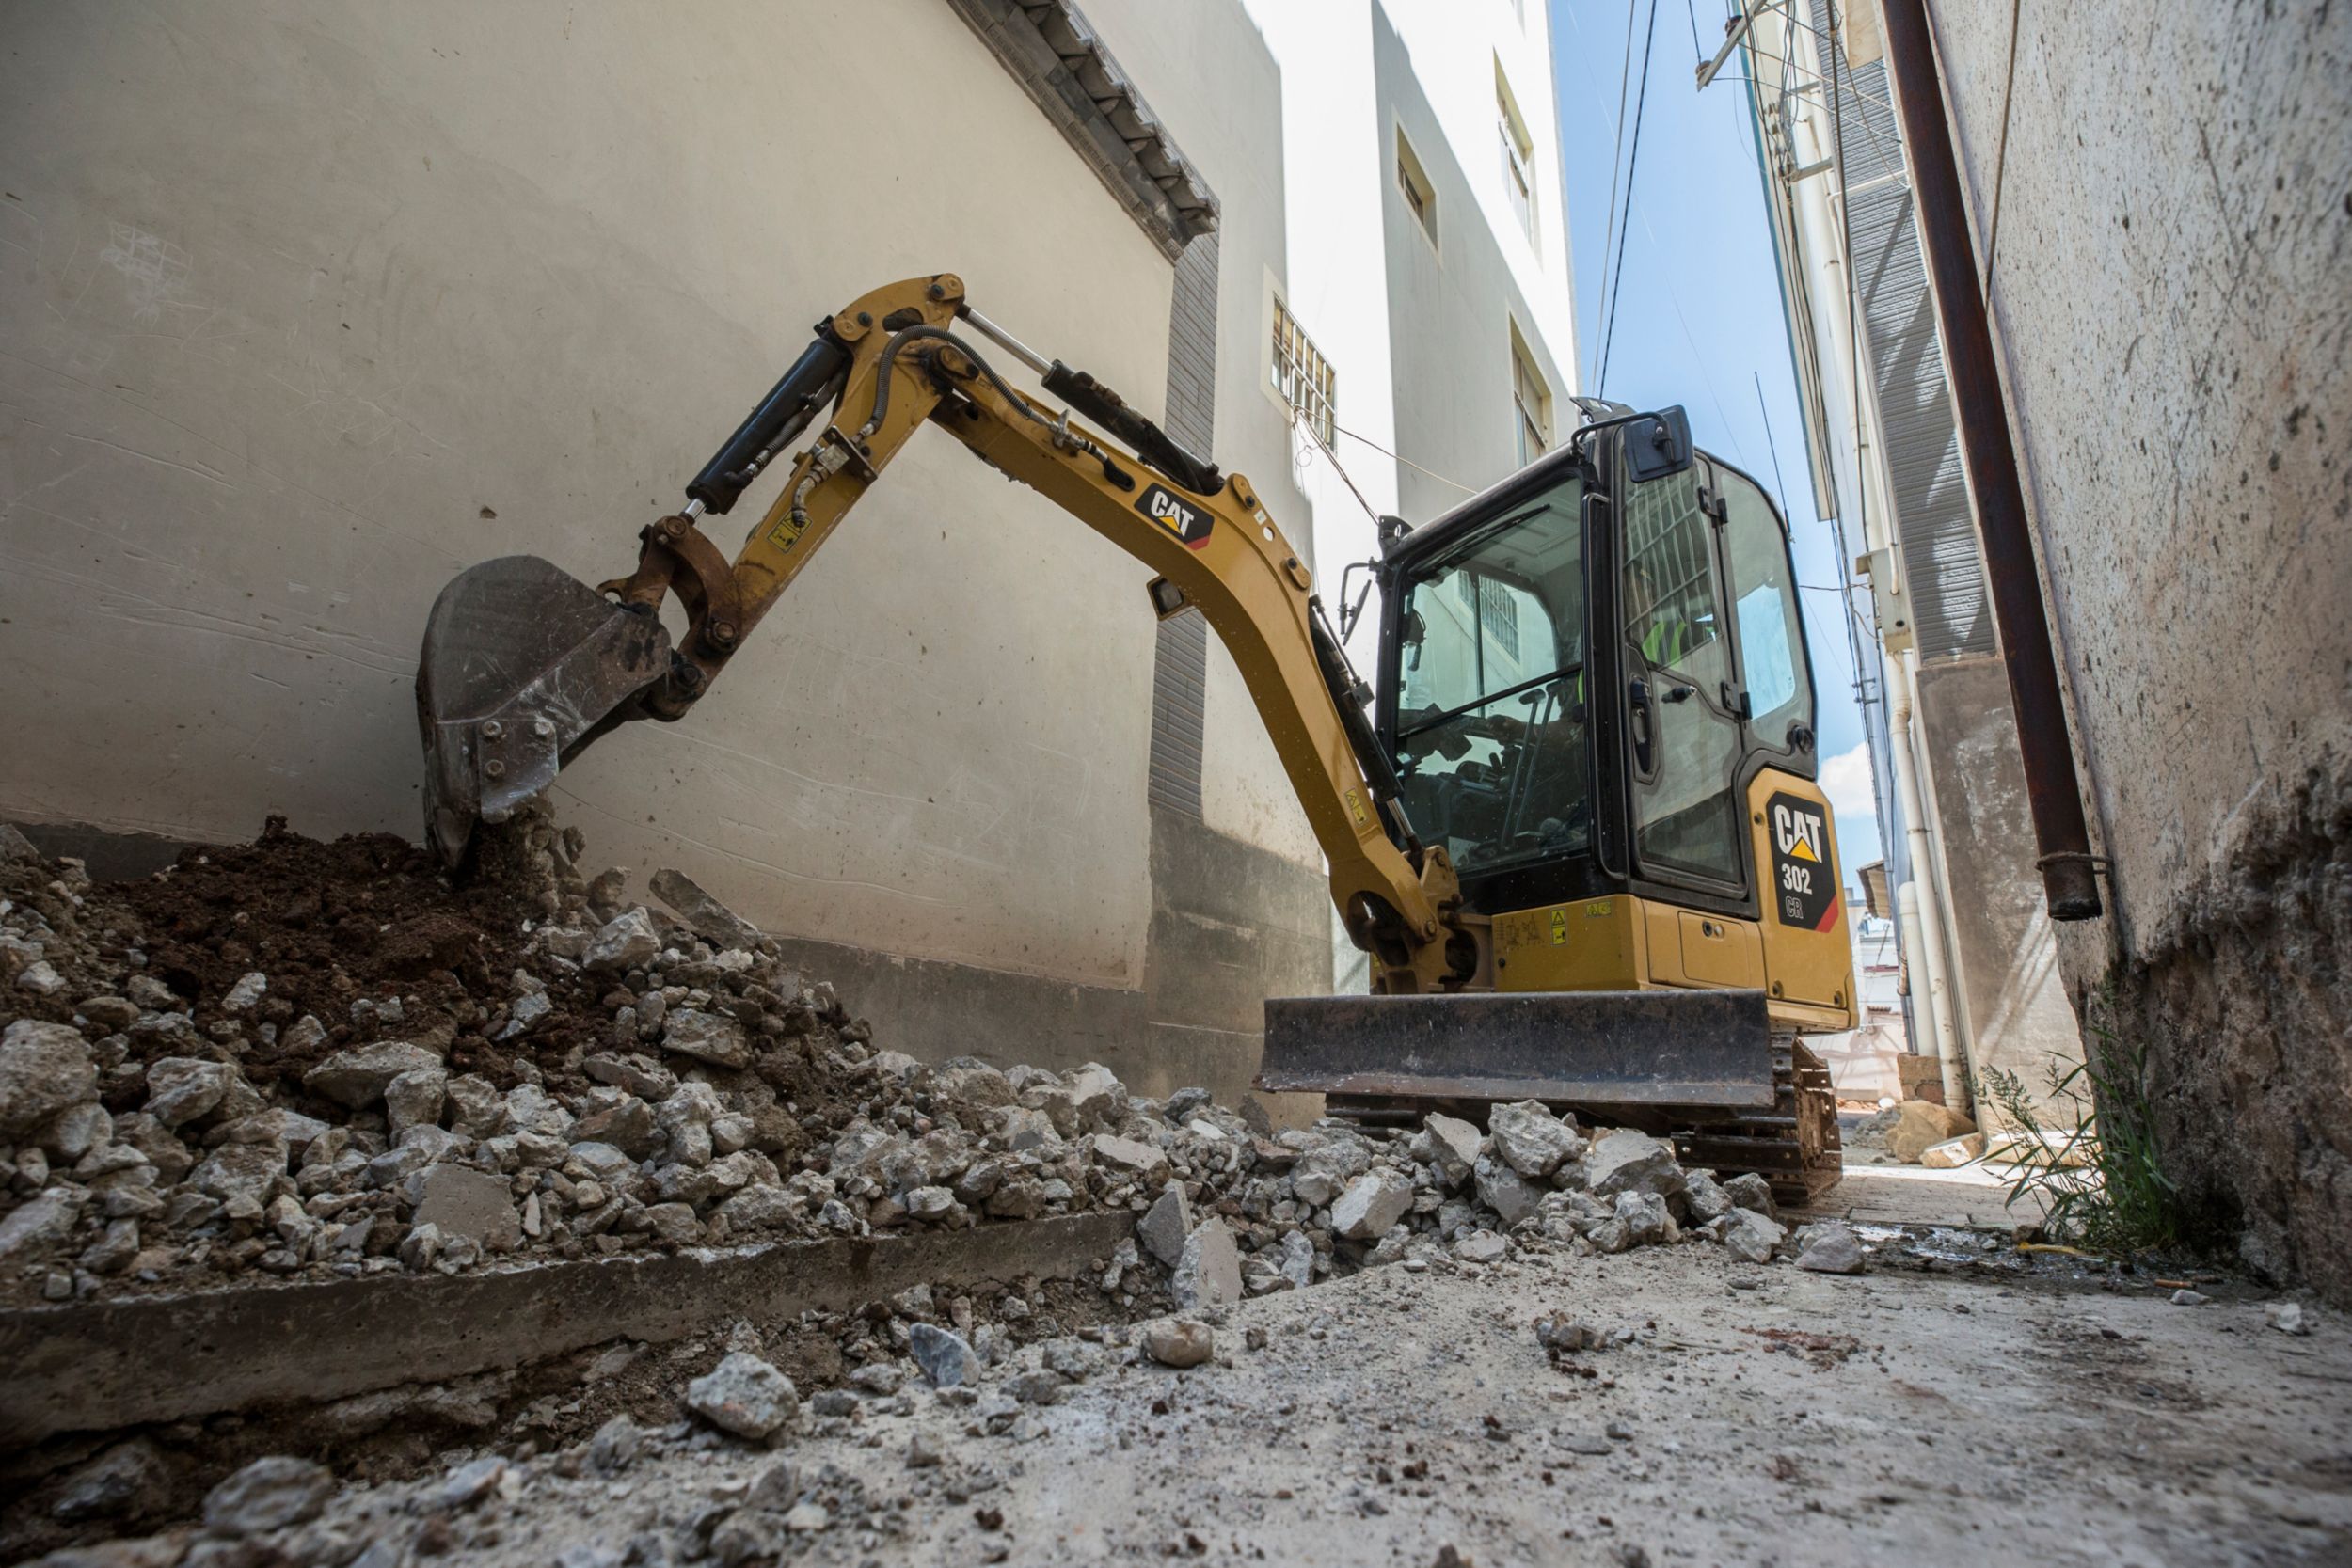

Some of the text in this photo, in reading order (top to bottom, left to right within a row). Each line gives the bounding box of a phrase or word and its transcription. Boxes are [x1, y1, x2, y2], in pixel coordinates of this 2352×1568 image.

[1151, 491, 1195, 537] CAT
[1774, 804, 1822, 863] CAT
[1782, 863, 1813, 895] 302
[1786, 896, 1804, 919] CR
